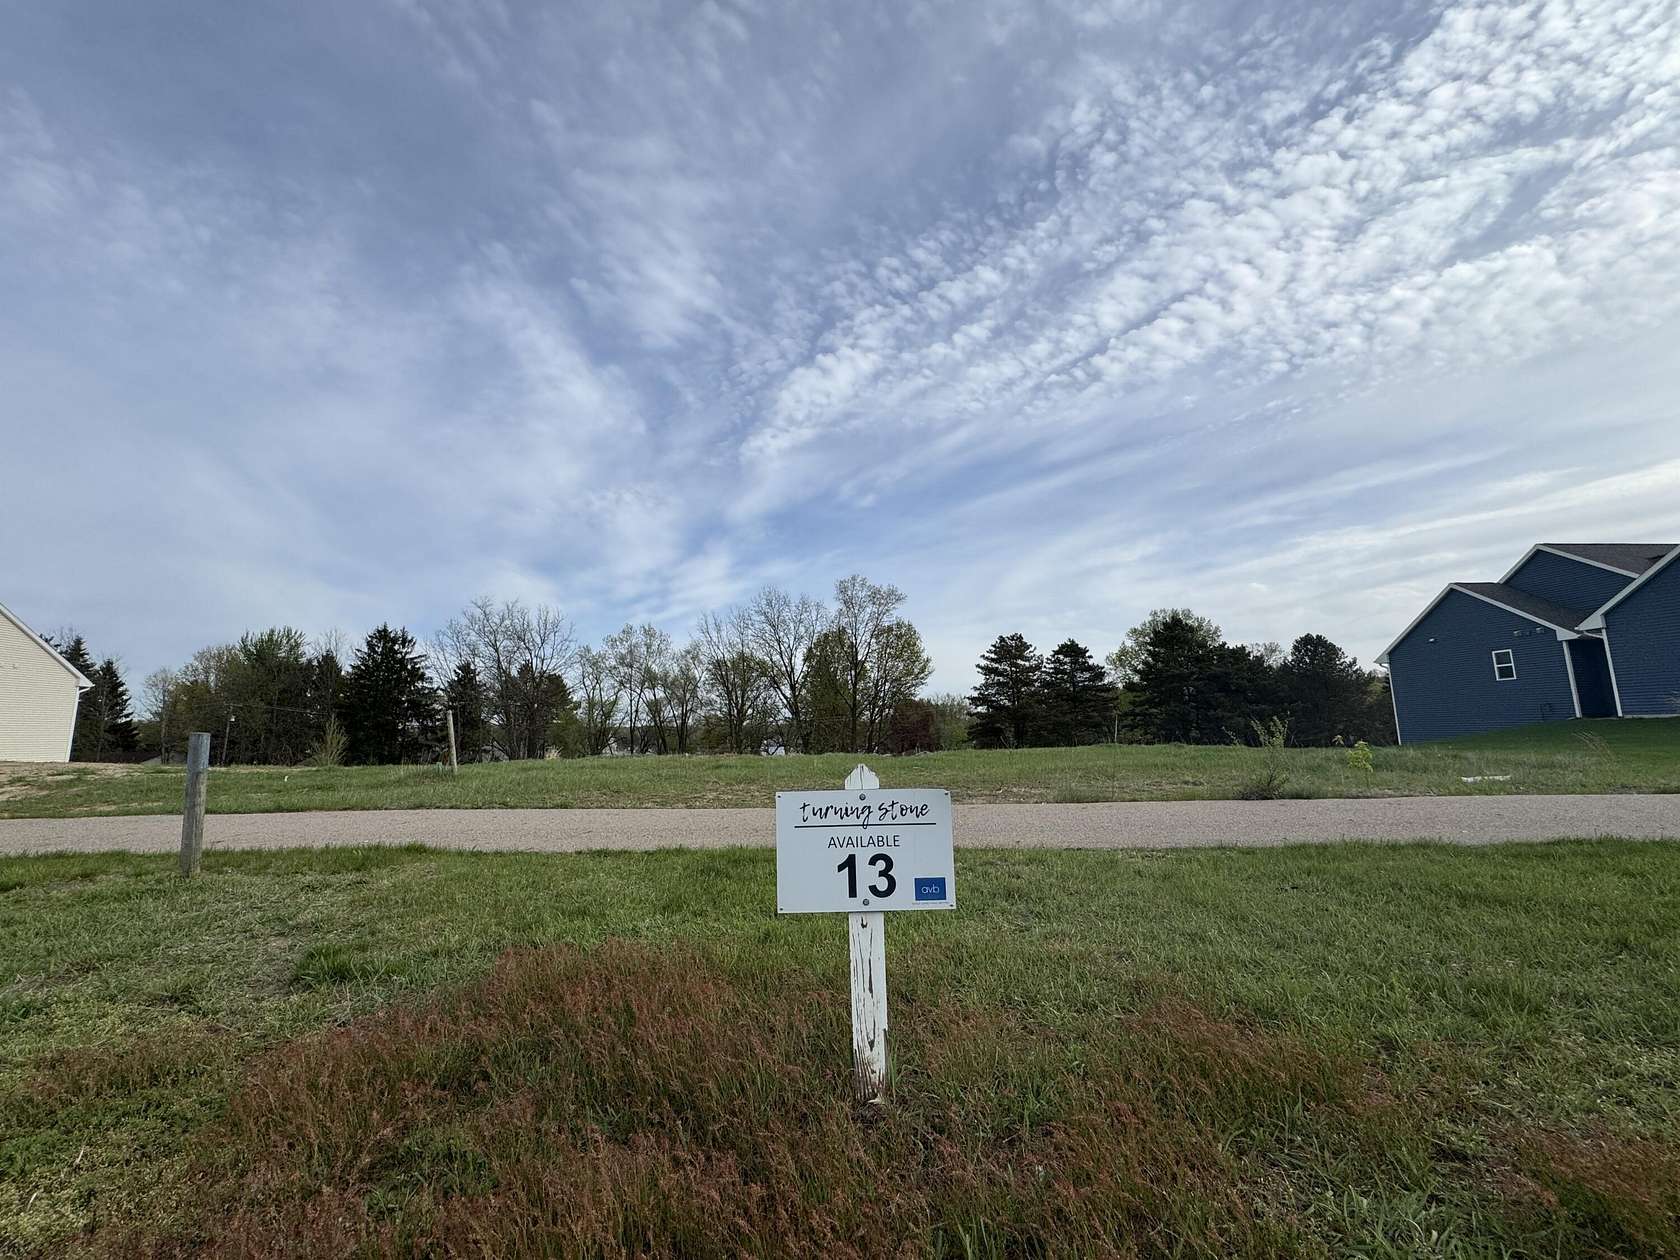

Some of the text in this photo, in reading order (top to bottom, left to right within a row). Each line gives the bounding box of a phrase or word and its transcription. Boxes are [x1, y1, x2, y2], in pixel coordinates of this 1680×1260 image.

[800, 800, 929, 829] turning stone
[827, 835, 900, 848] AVAILABLE
[837, 853, 897, 898] 13
[921, 884, 940, 893] avb
